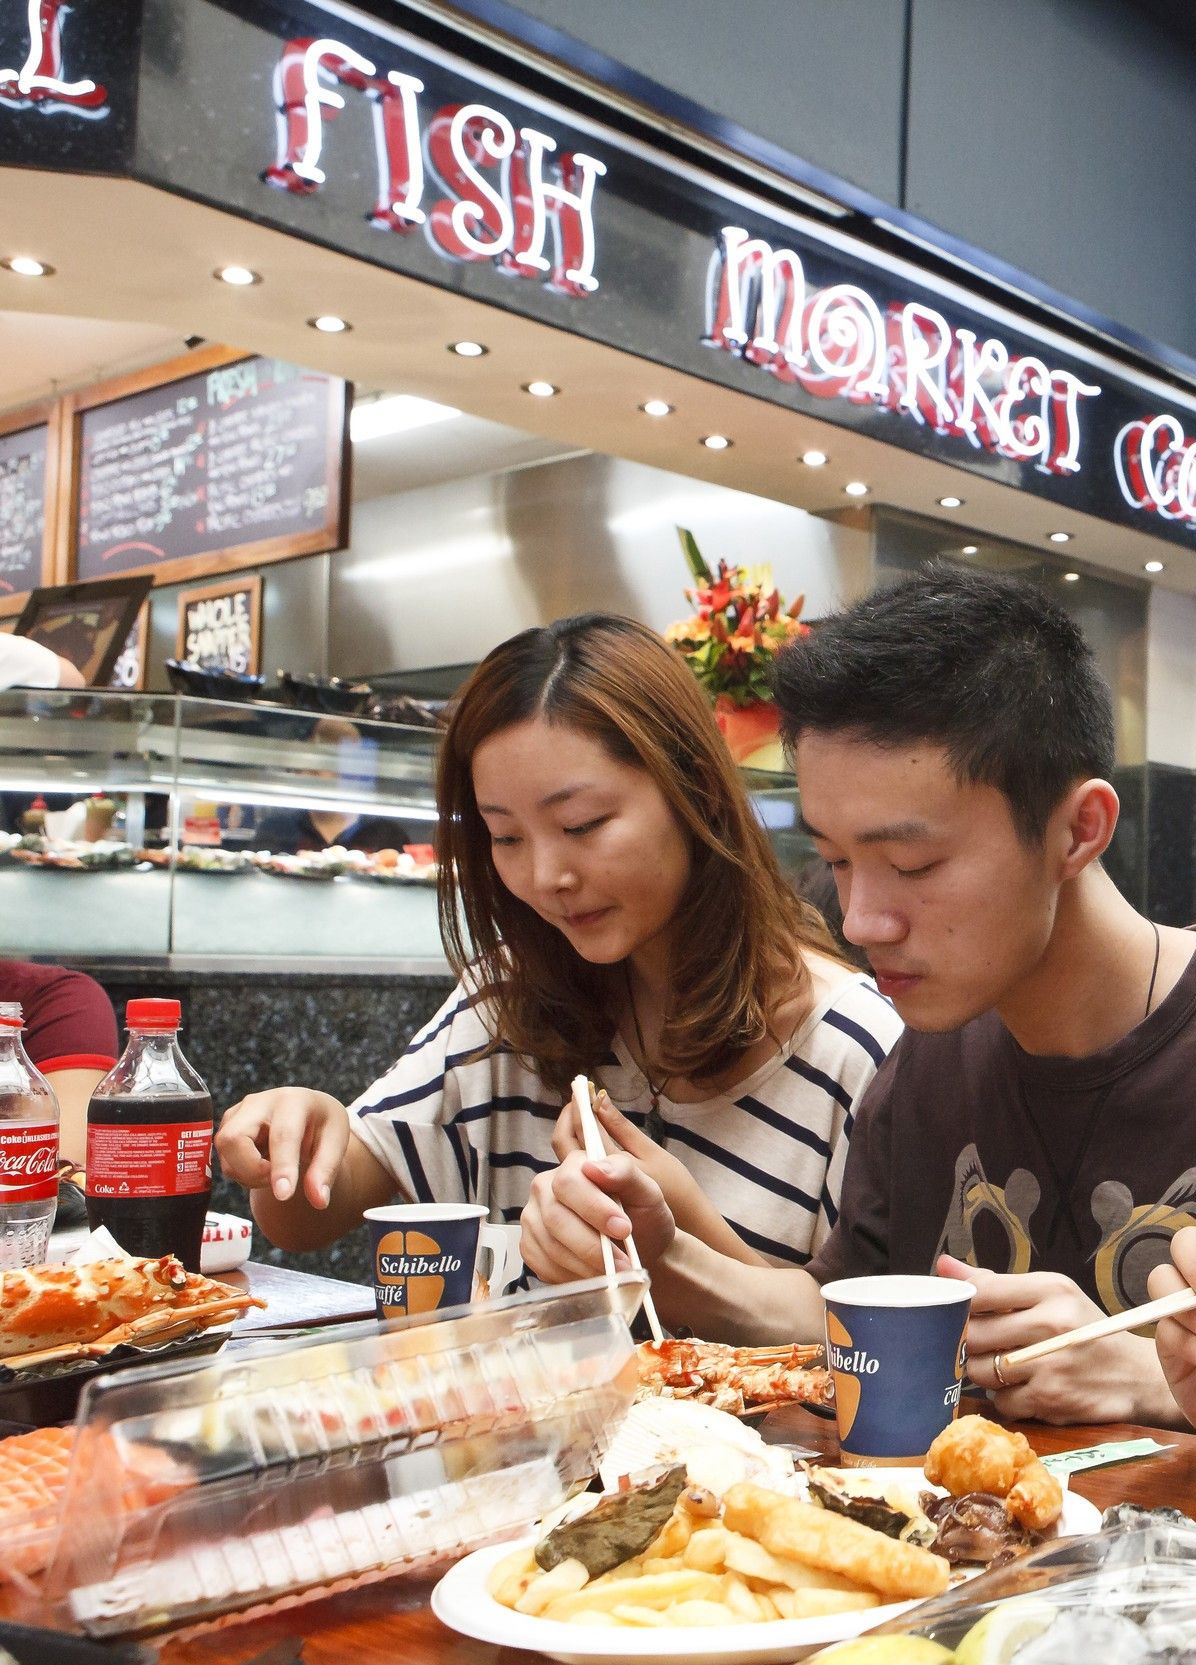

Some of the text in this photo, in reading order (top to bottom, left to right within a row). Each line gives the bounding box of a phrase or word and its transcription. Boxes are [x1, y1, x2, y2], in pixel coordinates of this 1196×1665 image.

[262, 37, 607, 297] FISH
[0, 1146, 57, 1175] oca-Cola
[95, 1184, 115, 1193] Coke
[381, 1255, 461, 1274] Schibello
